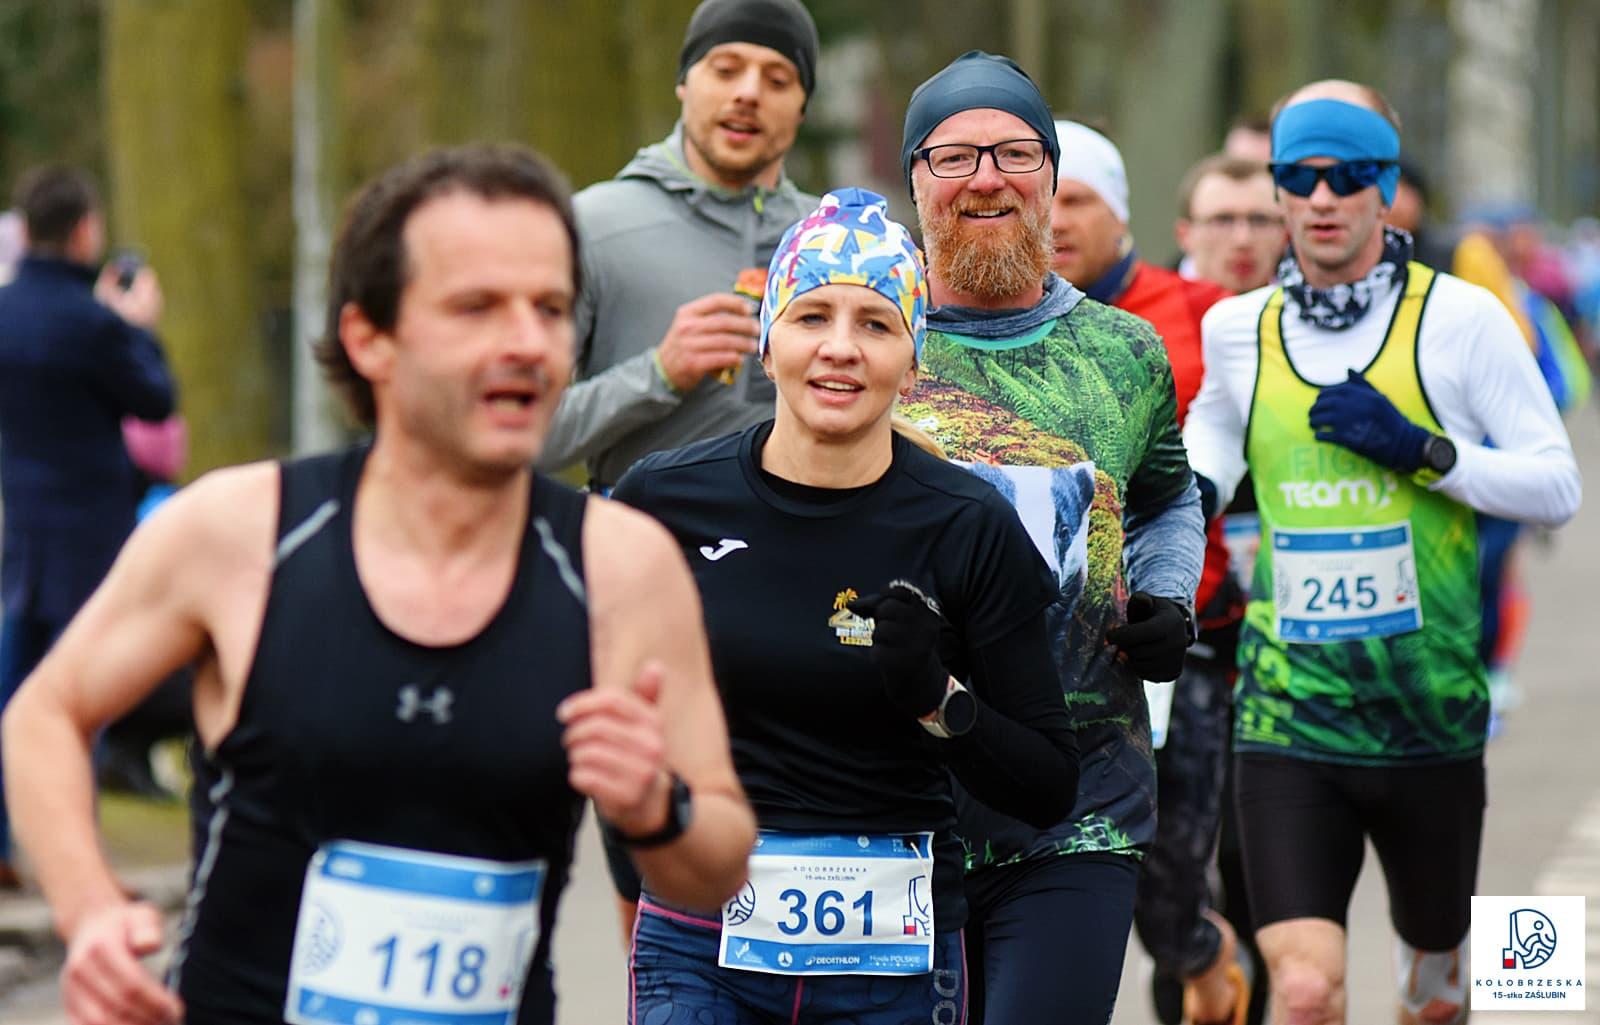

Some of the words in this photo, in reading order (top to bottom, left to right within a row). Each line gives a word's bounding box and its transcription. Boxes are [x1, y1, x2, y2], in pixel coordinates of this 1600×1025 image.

[1304, 576, 1378, 612] 245
[777, 888, 873, 937] 361
[373, 934, 487, 1000] 118
[816, 956, 860, 965] DECATHLON
